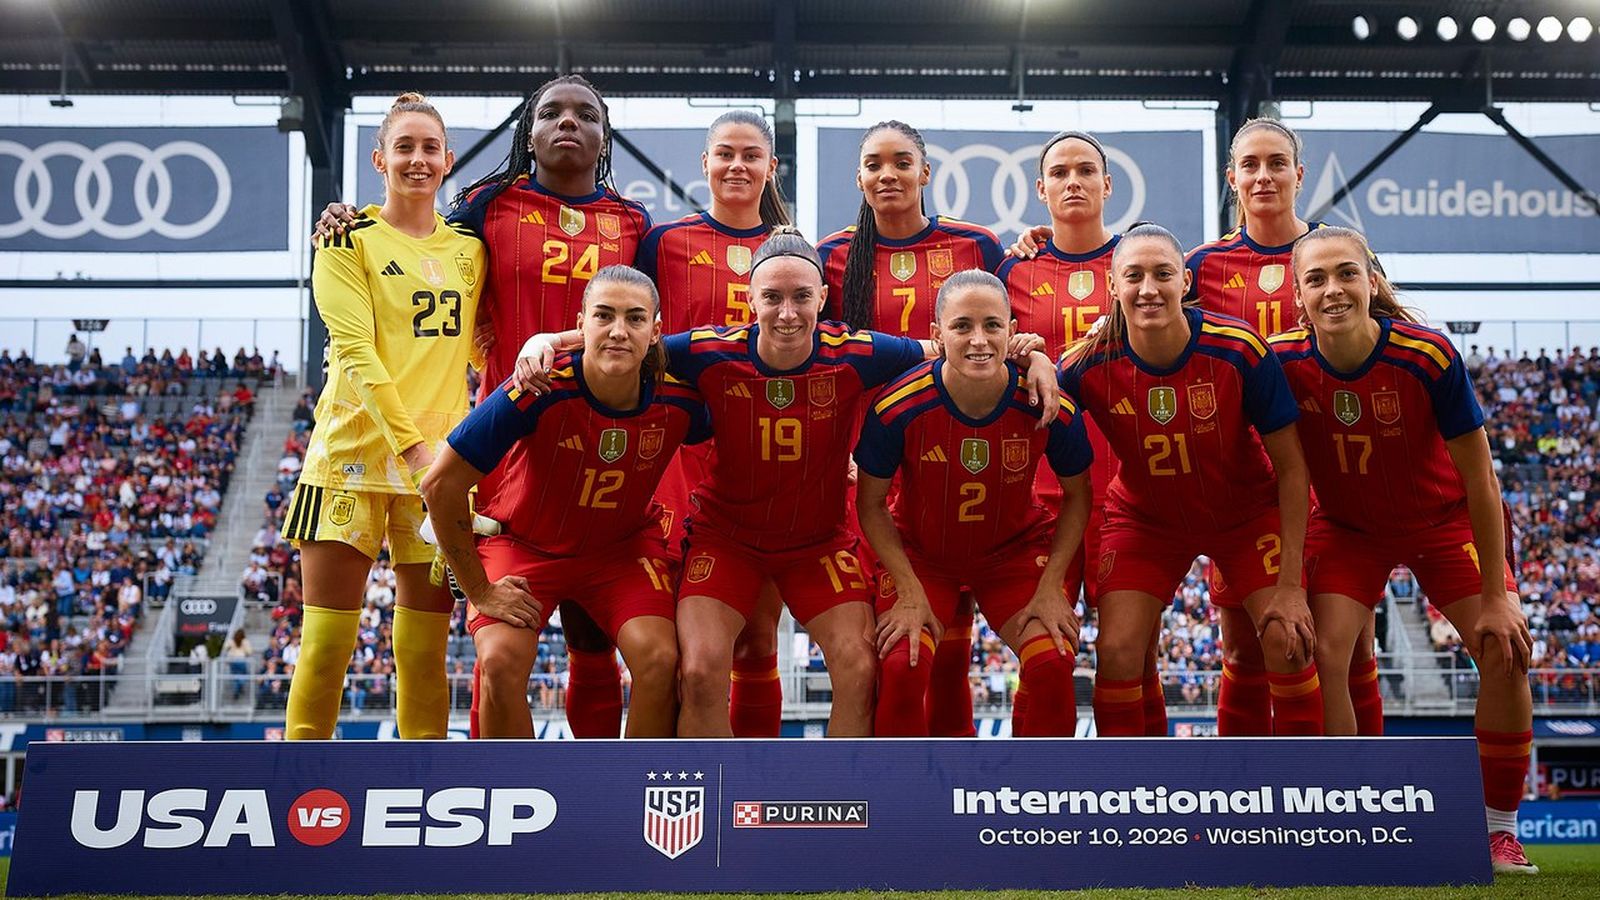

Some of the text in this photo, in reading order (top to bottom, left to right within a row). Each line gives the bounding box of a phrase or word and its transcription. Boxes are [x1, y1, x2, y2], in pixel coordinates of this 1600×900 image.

[1366, 178, 1600, 218] Guidehous
[542, 240, 600, 284] 24
[412, 290, 462, 337] 23
[725, 283, 751, 327] 5
[893, 287, 916, 332] 7
[1256, 301, 1282, 340] 11
[759, 417, 802, 461] 19
[1144, 433, 1191, 475] 21
[1332, 434, 1372, 475] 17
[578, 468, 625, 508] 12
[958, 482, 987, 522] 2
[820, 550, 867, 593] 19
[71, 788, 276, 849] USA
[361, 787, 558, 847] ESP
[649, 790, 701, 817] USA
[953, 785, 1435, 814] International Match
[979, 826, 1413, 847] October 10, 2026 Washington, D.C.
[1516, 814, 1598, 839] erican
